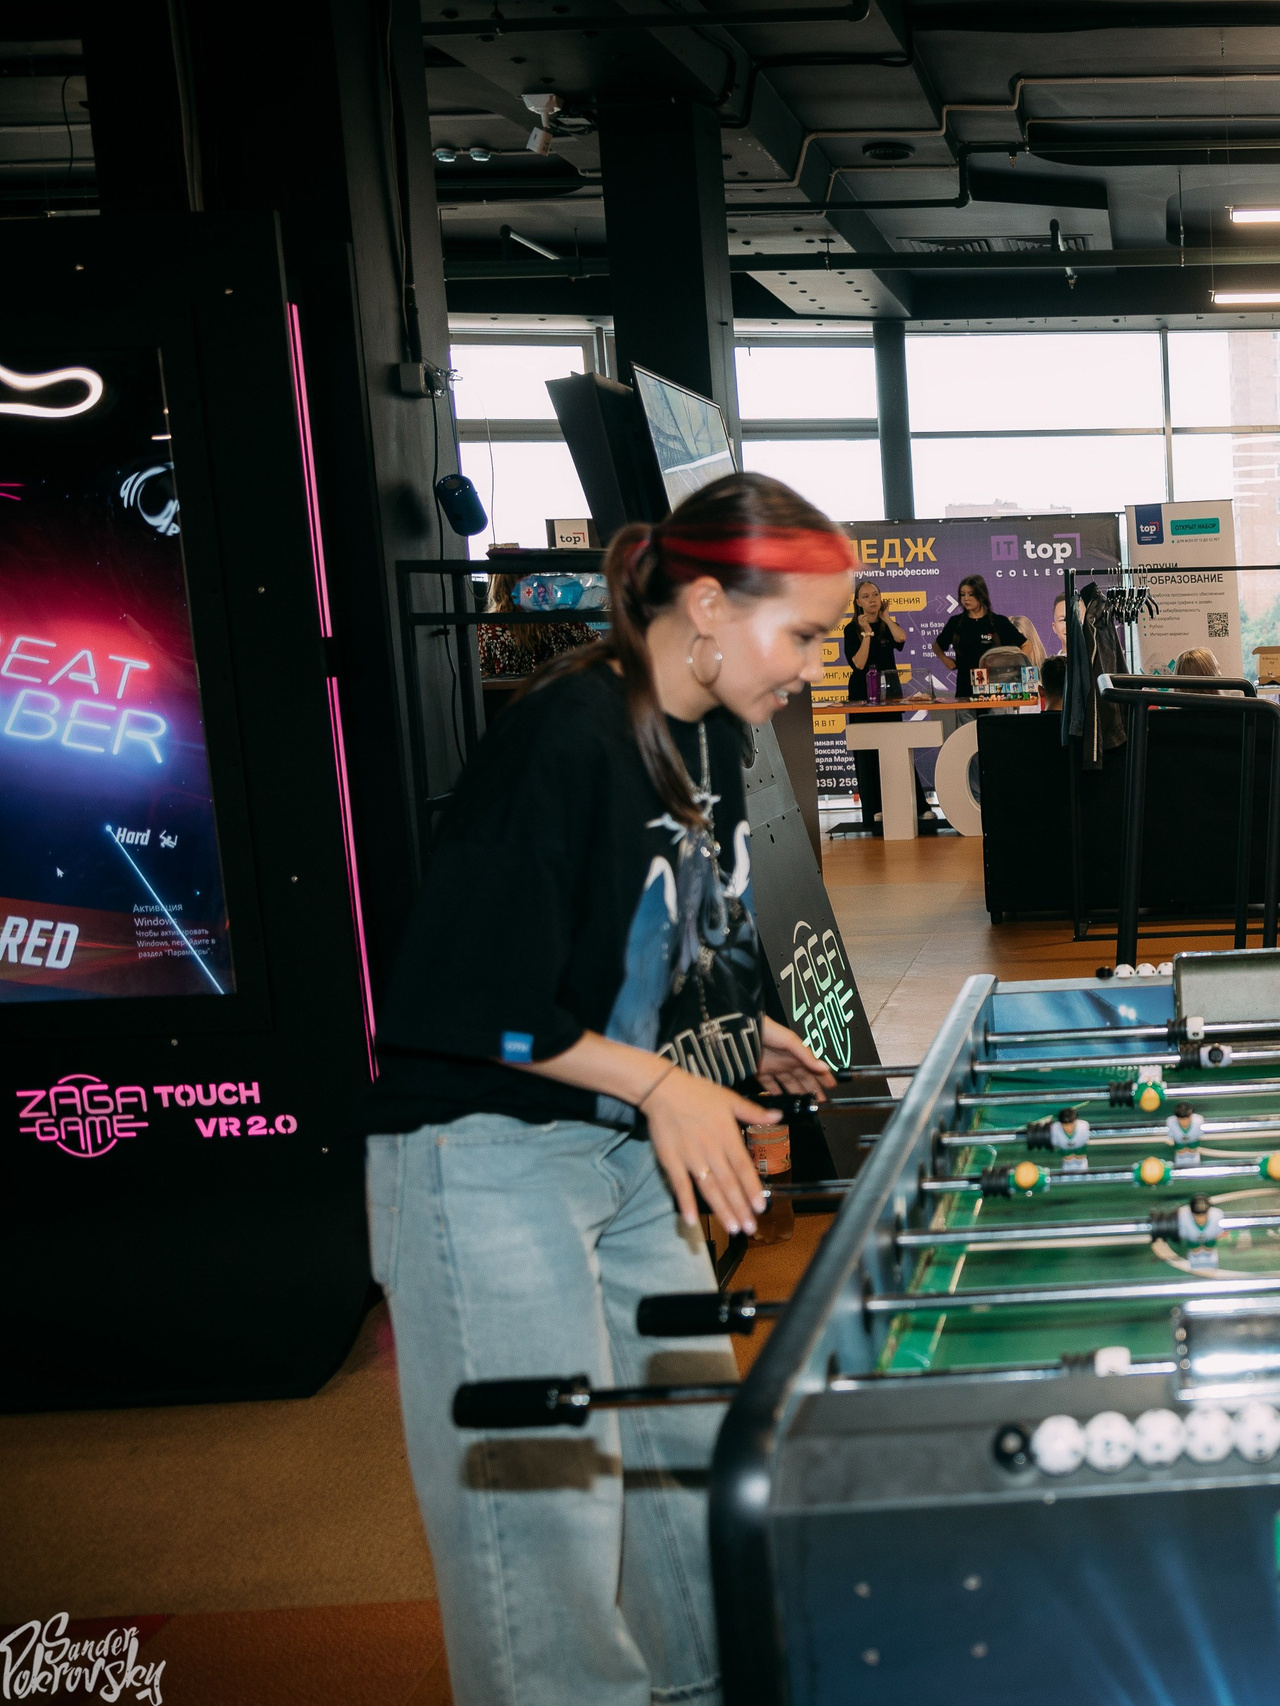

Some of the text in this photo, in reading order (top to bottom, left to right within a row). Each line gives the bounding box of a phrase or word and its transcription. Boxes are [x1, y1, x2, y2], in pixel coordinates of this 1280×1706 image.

[1139, 524, 1157, 534] top
[560, 535, 581, 545] top
[996, 540, 1072, 564] IT top
[886, 567, 940, 578] профессию
[996, 568, 1064, 577] COLLEG
[1138, 573, 1224, 586] IT-ОБРАЗОВАНИЕ
[0, 636, 150, 699] EAT
[823, 672, 841, 680] ИНГ,
[4, 689, 167, 764] BER
[839, 777, 858, 787] 256
[116, 827, 151, 846] Hard
[134, 917, 177, 927] Windows
[0, 916, 79, 970] RED
[137, 940, 170, 948] Windows,
[138, 951, 163, 959] раздел
[780, 929, 846, 1022] ZAGA
[802, 980, 854, 1067] GAME
[16, 1082, 261, 1118] ZAGA TOUCH
[20, 1114, 299, 1150] GAME VR 2.0
